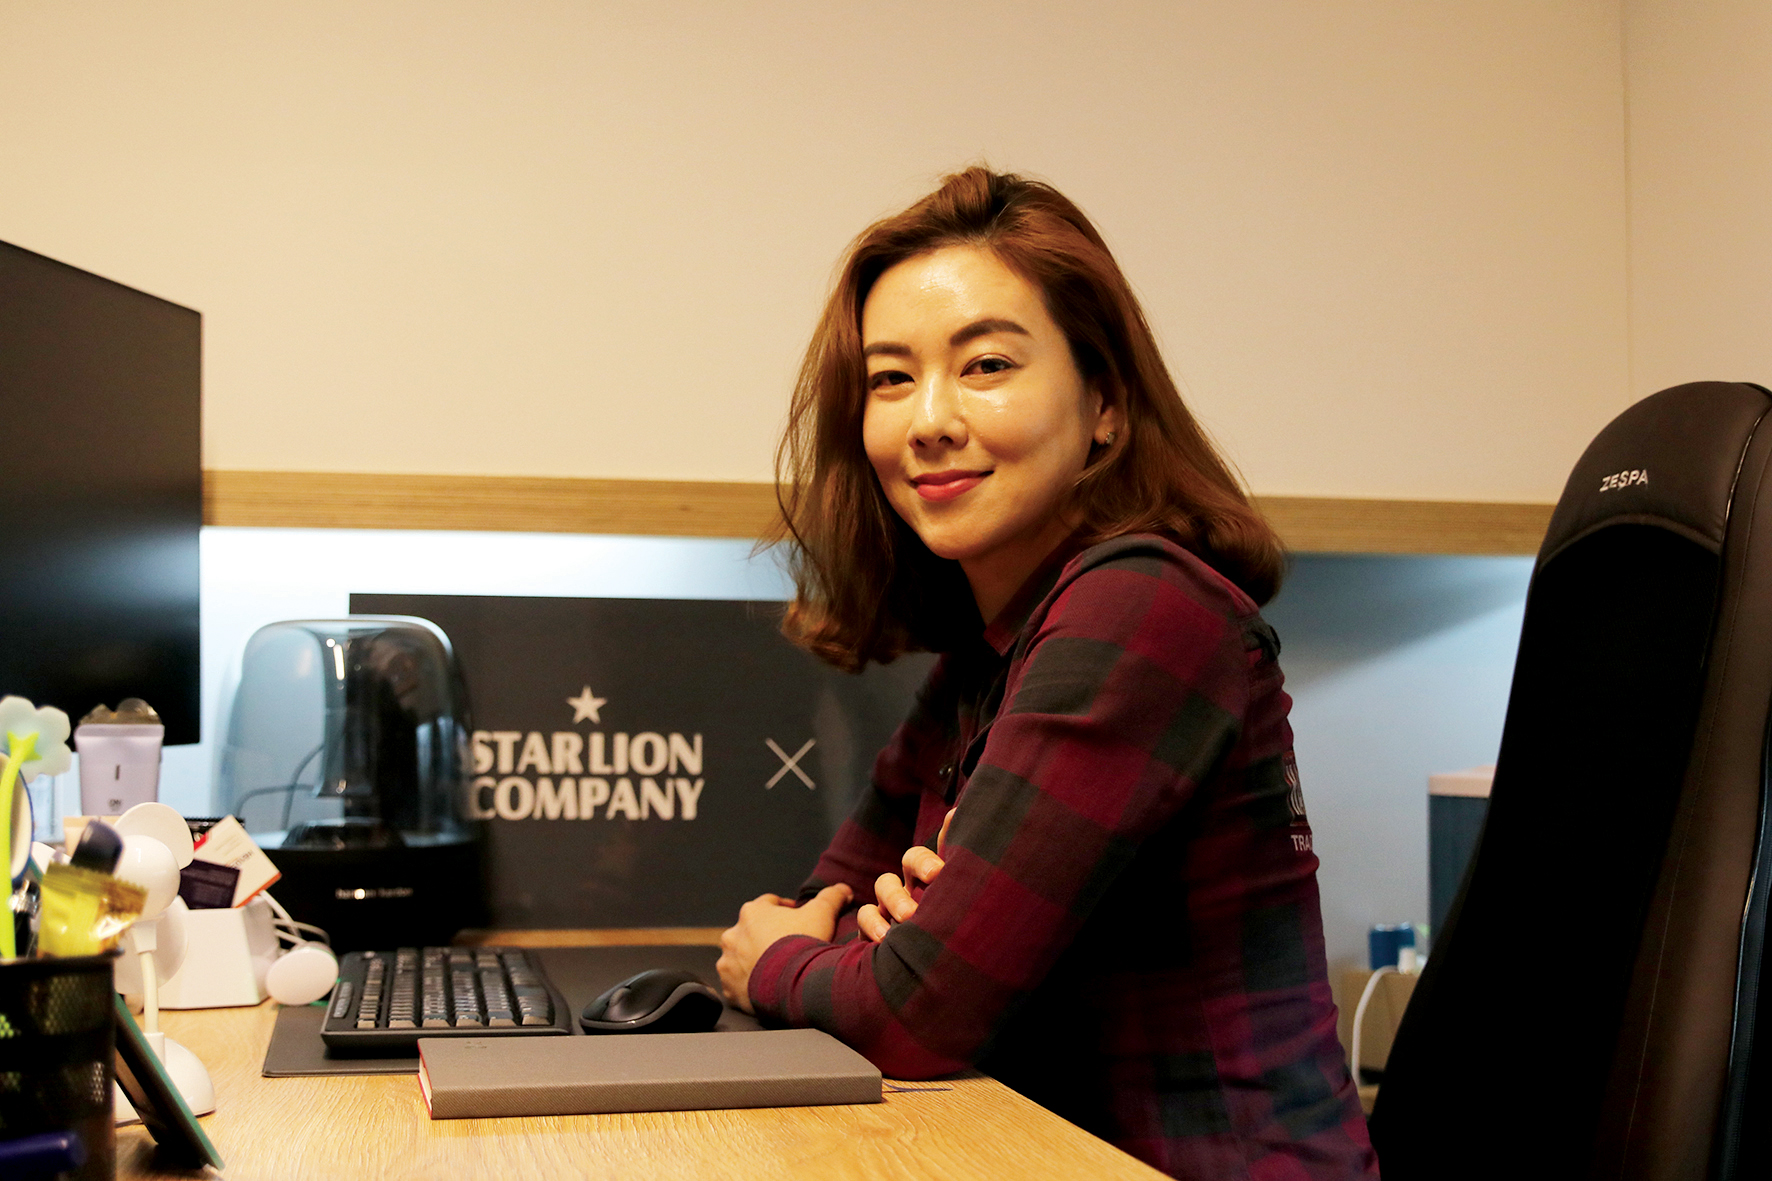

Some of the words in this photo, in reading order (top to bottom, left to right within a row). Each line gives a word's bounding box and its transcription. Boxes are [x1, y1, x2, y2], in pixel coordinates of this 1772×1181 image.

[1599, 468, 1649, 492] ZESPA
[470, 777, 705, 821] COMPANY
[1290, 834, 1313, 851] TRA
